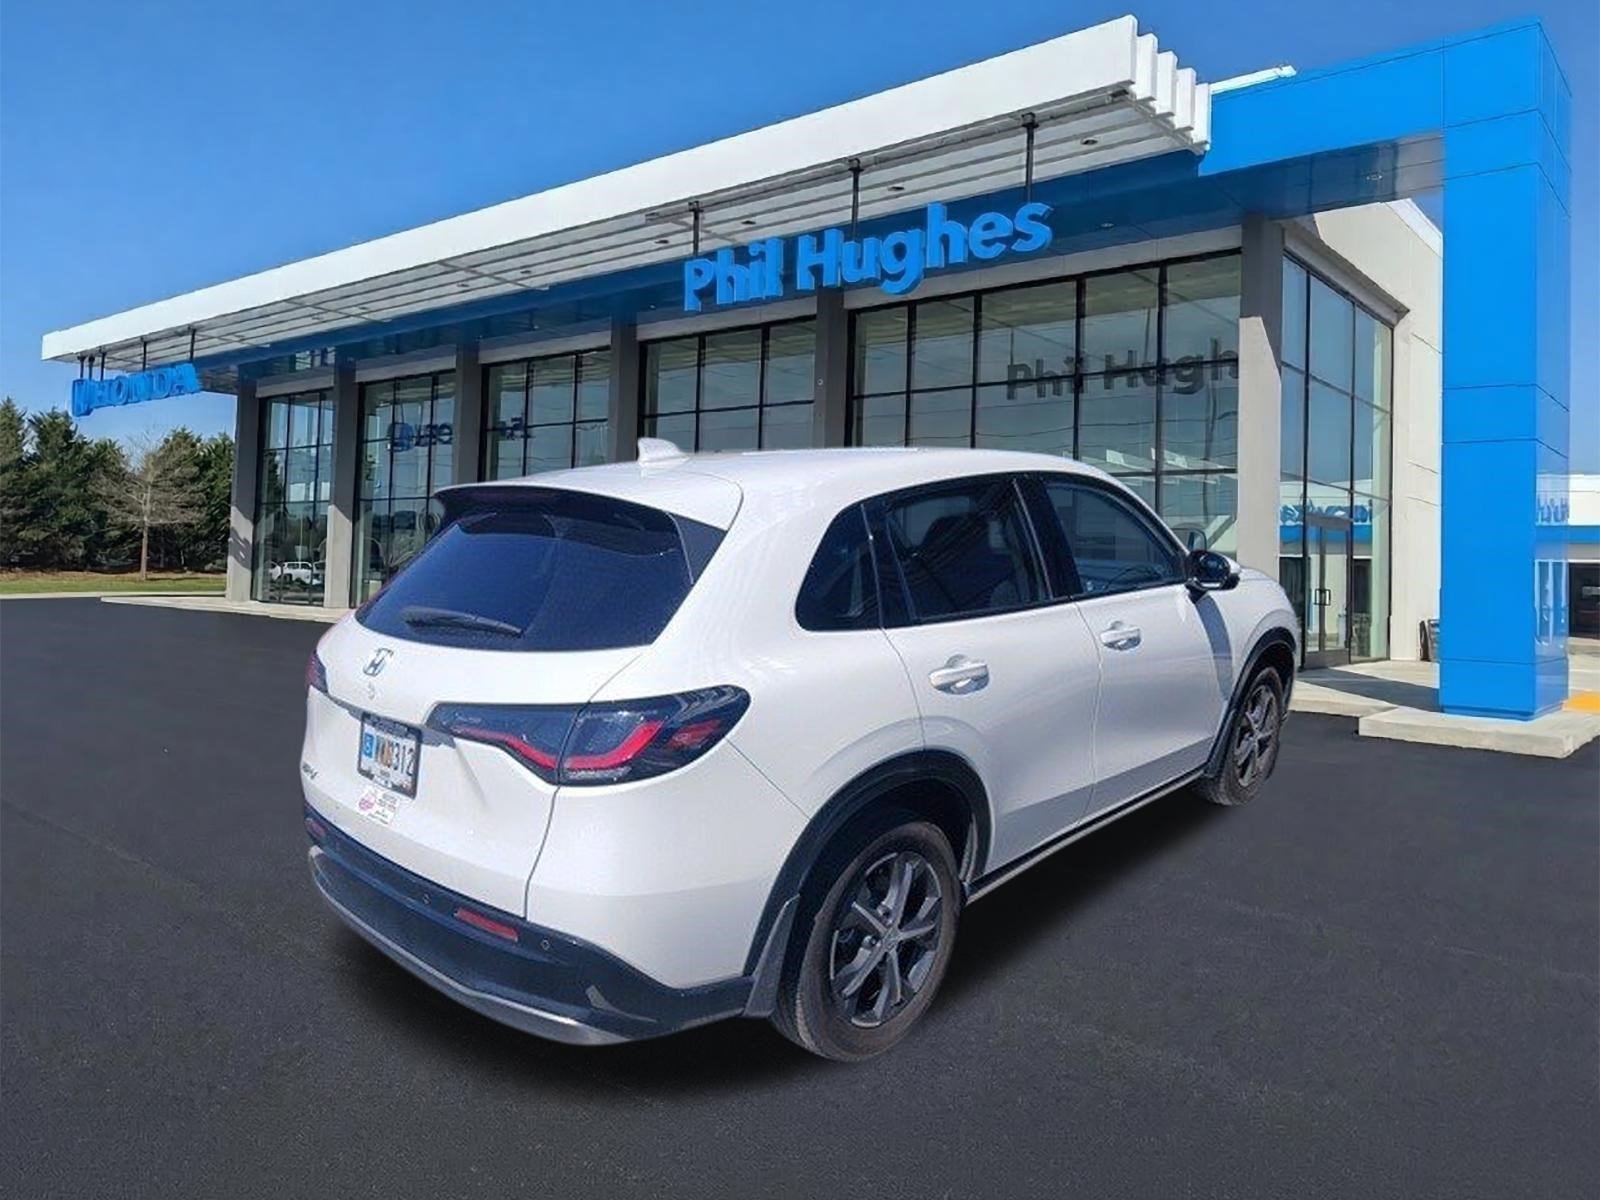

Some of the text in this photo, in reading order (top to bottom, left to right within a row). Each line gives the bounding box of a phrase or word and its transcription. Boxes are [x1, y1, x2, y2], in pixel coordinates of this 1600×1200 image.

[684, 202, 1053, 311] Phil Hughes
[91, 363, 198, 409] HONDA
